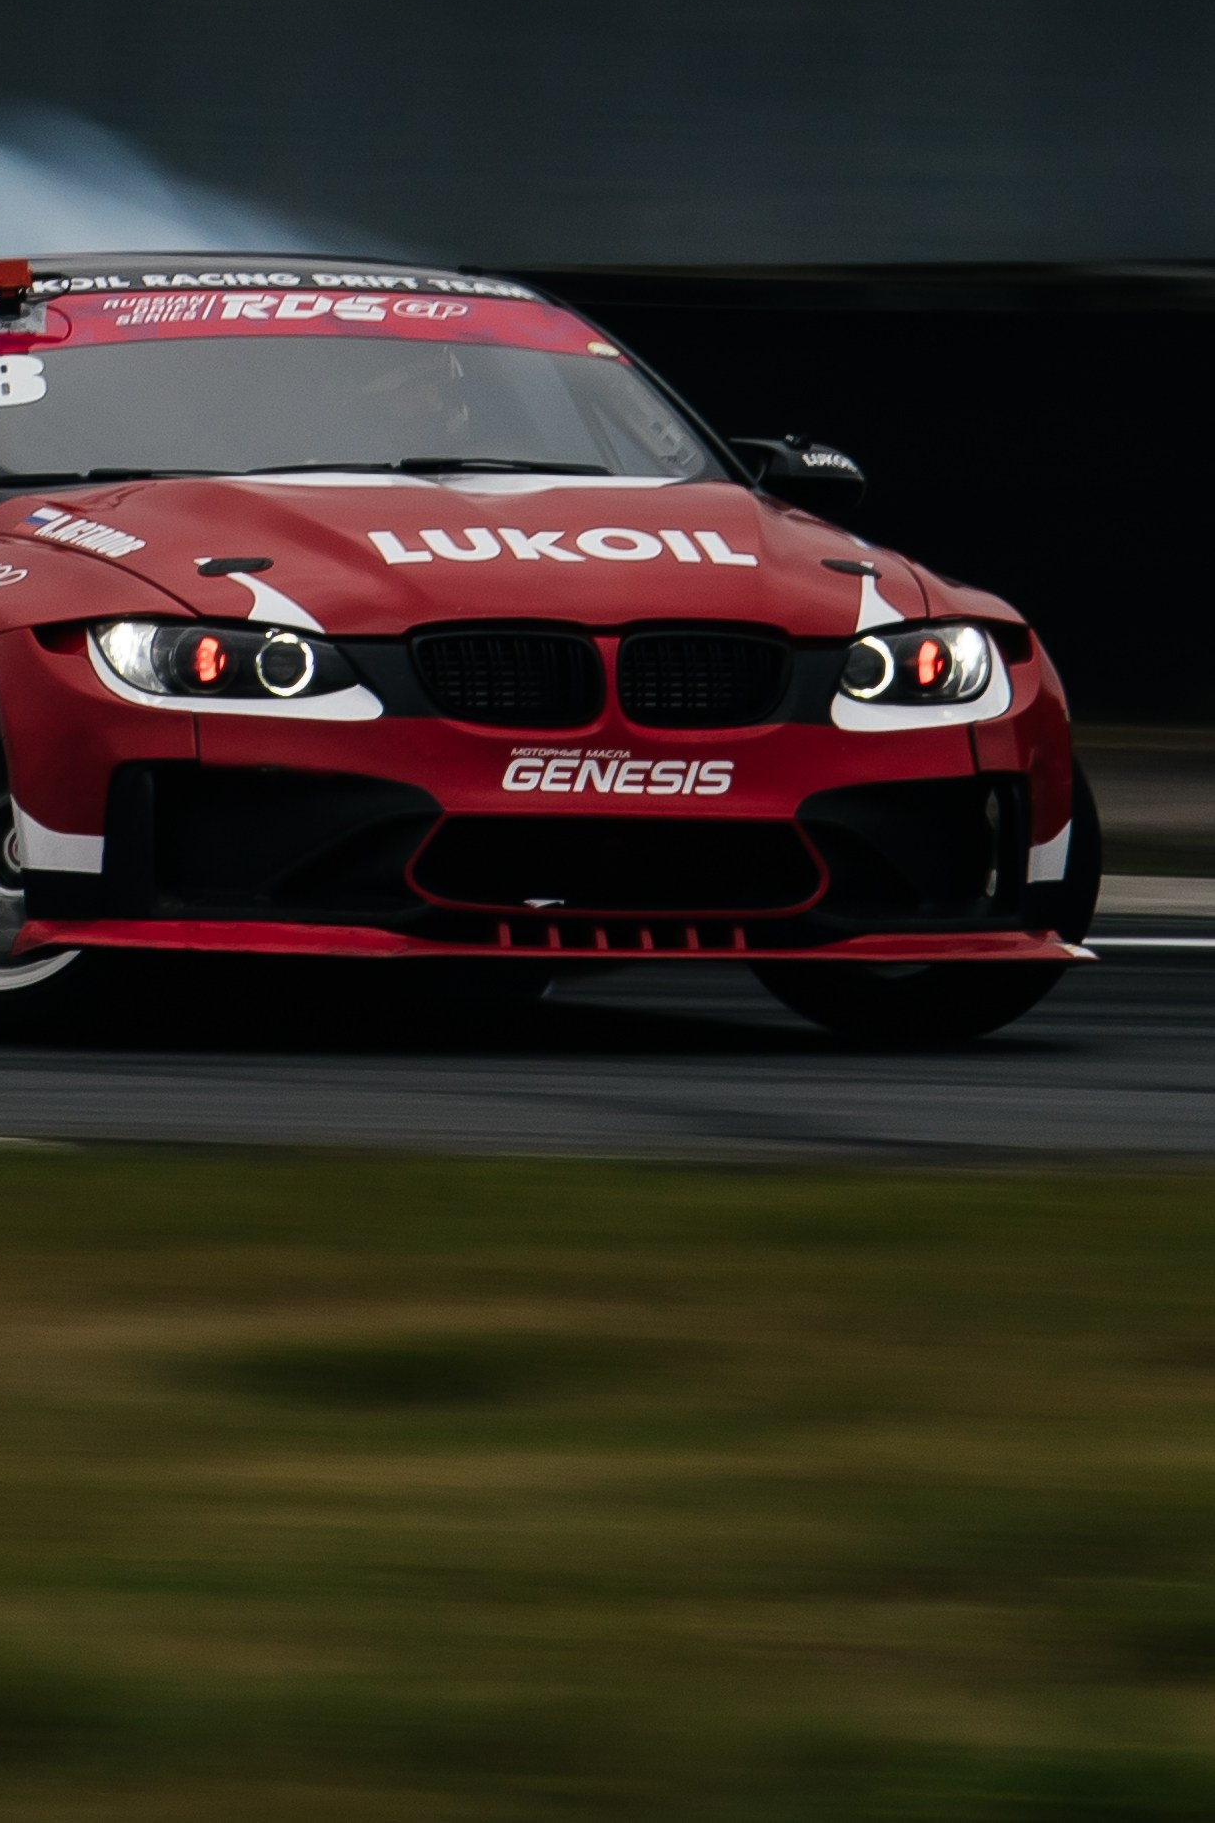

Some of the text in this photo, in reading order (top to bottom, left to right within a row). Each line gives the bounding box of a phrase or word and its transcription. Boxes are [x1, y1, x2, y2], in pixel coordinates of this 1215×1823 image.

[141, 273, 301, 288] RACING
[311, 273, 419, 290] DRIFT
[428, 278, 537, 301] TEAM
[102, 294, 206, 310] RUSSIAN
[221, 293, 390, 322] RDS
[115, 310, 197, 327] SERIES
[367, 527, 758, 567] LUKOIL
[510, 747, 631, 758] МОТОРНЫЕ МАСЛА
[501, 757, 734, 795] GENESIS
